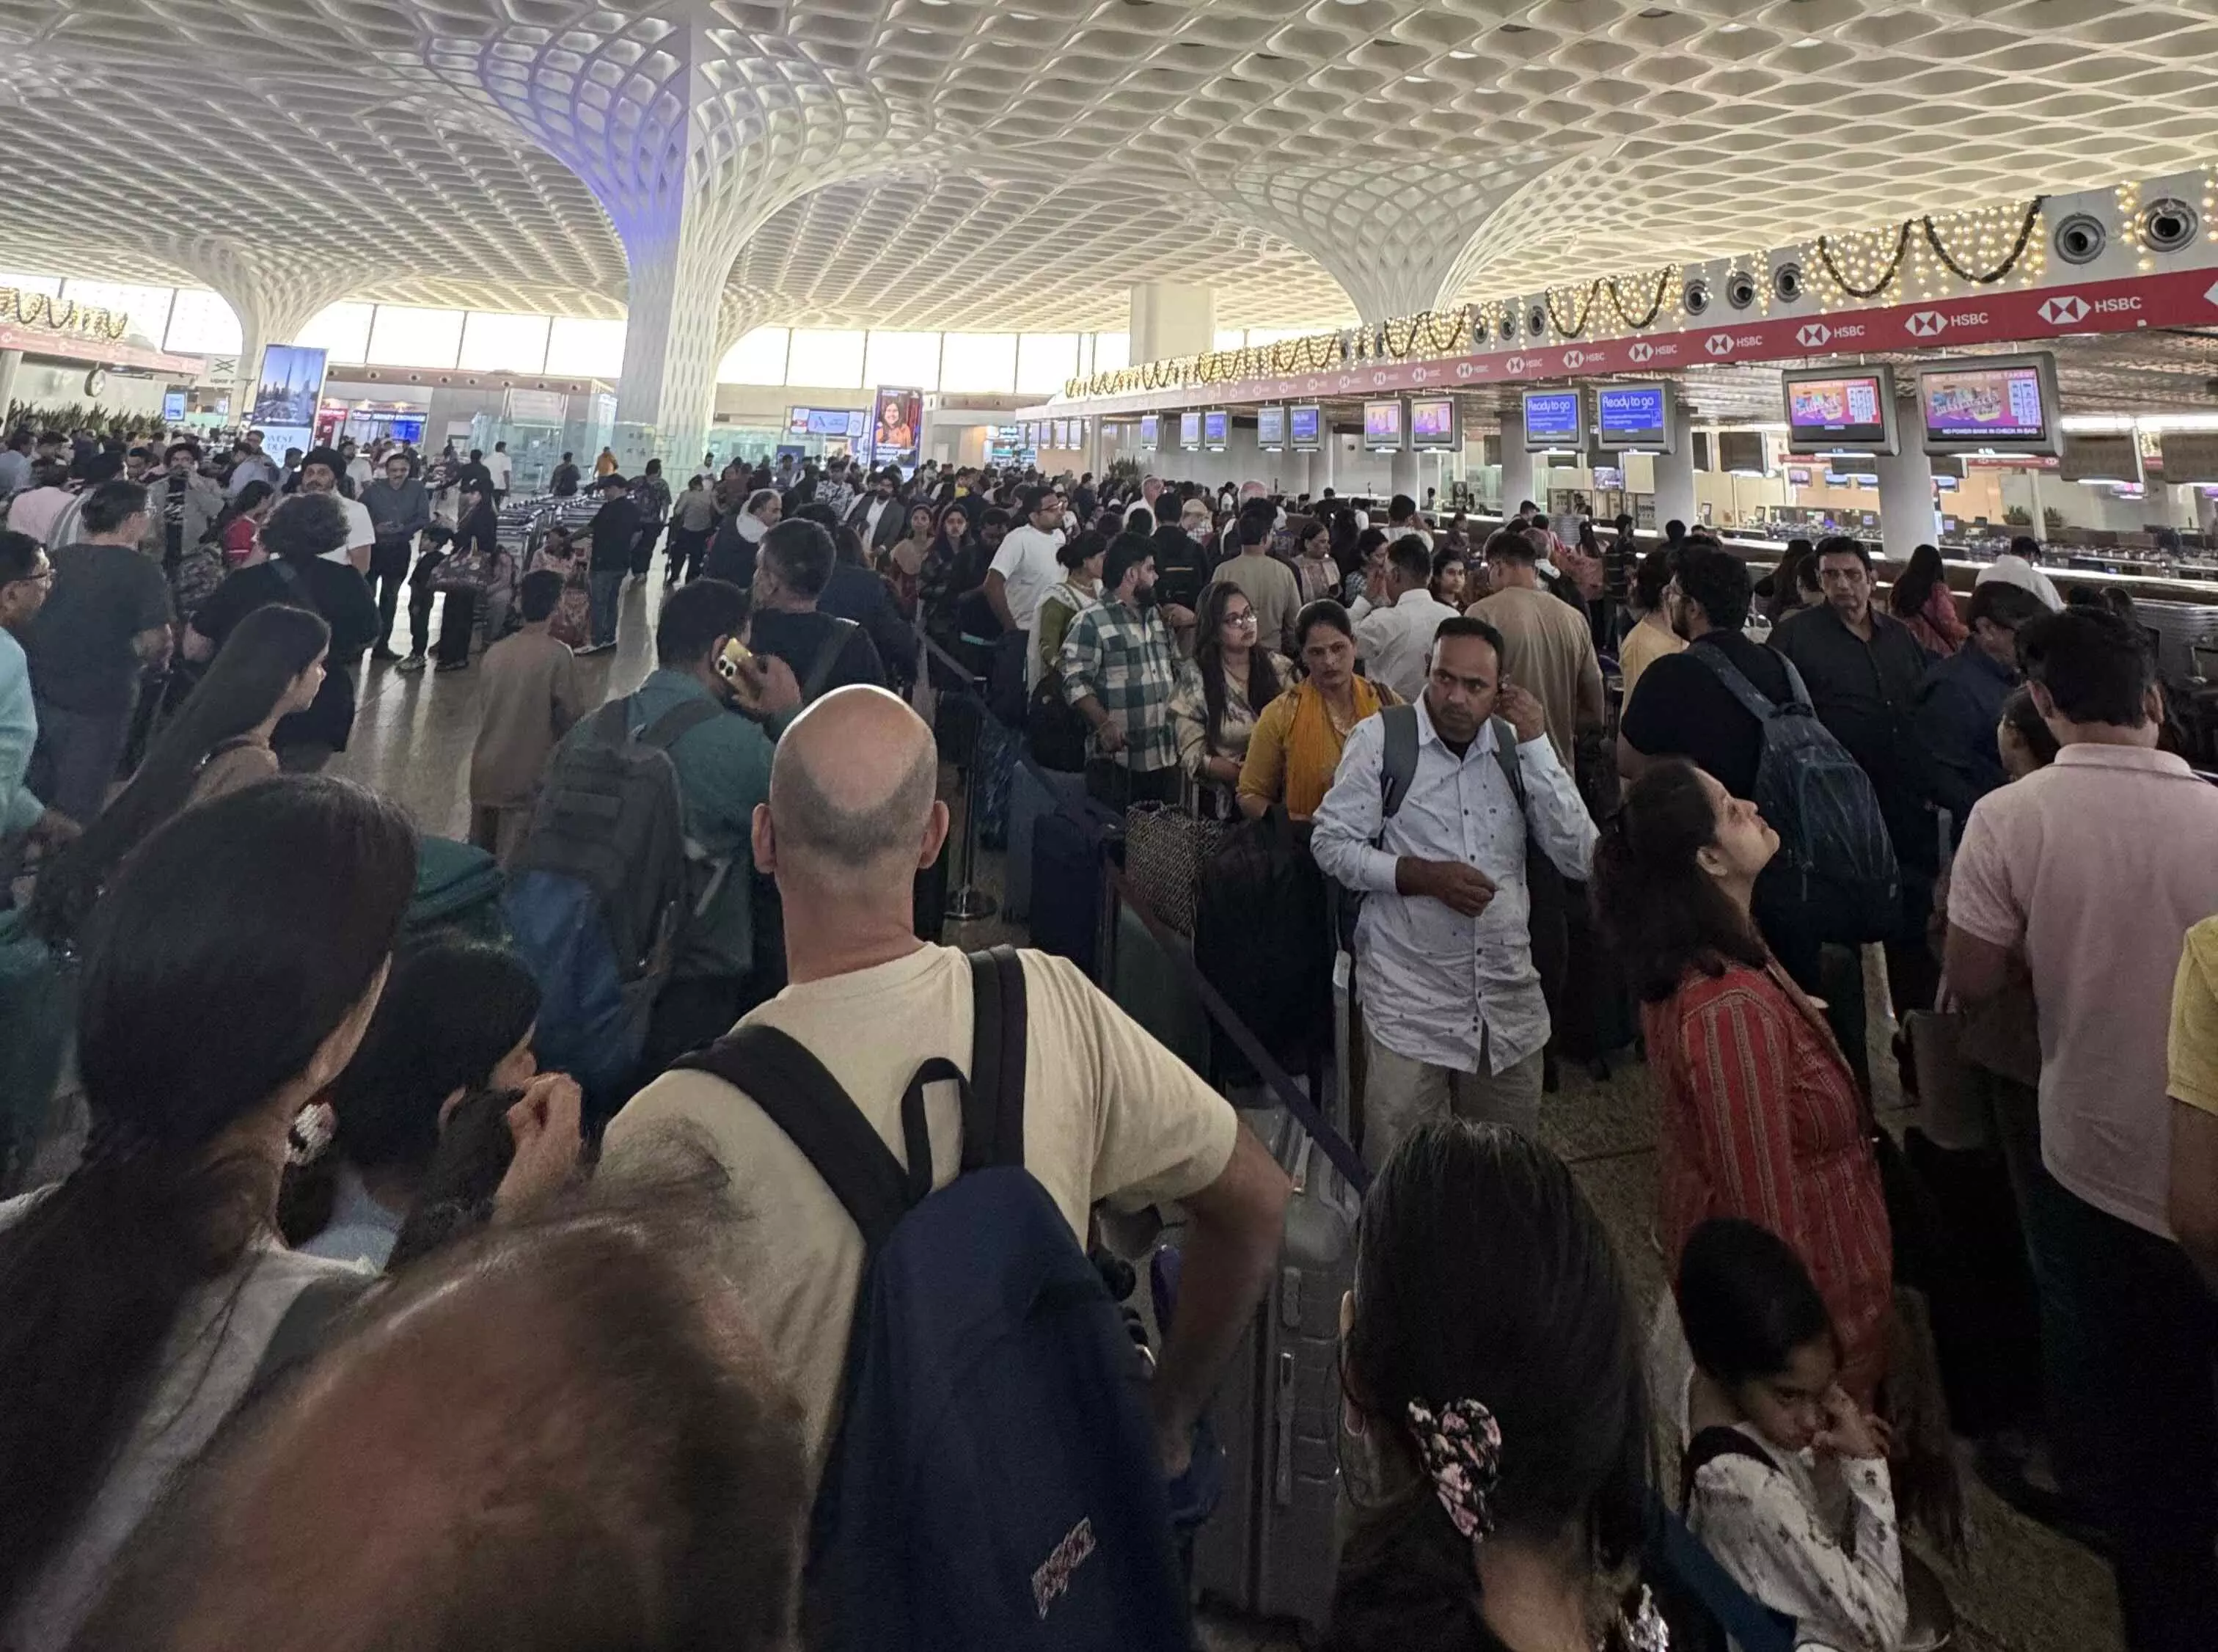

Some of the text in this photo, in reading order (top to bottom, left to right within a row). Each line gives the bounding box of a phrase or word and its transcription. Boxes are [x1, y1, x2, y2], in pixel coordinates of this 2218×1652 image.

[2094, 296, 2142, 313] HSBC
[1950, 313, 1988, 327] HSBC
[1834, 325, 1864, 338] HSBC
[1737, 336, 1763, 348] HSBC
[1655, 344, 1677, 356] HSBC
[1586, 352, 1605, 362] HSBC
[1528, 400, 1570, 413] Ready to go
[1603, 396, 1655, 411] Ready to go
